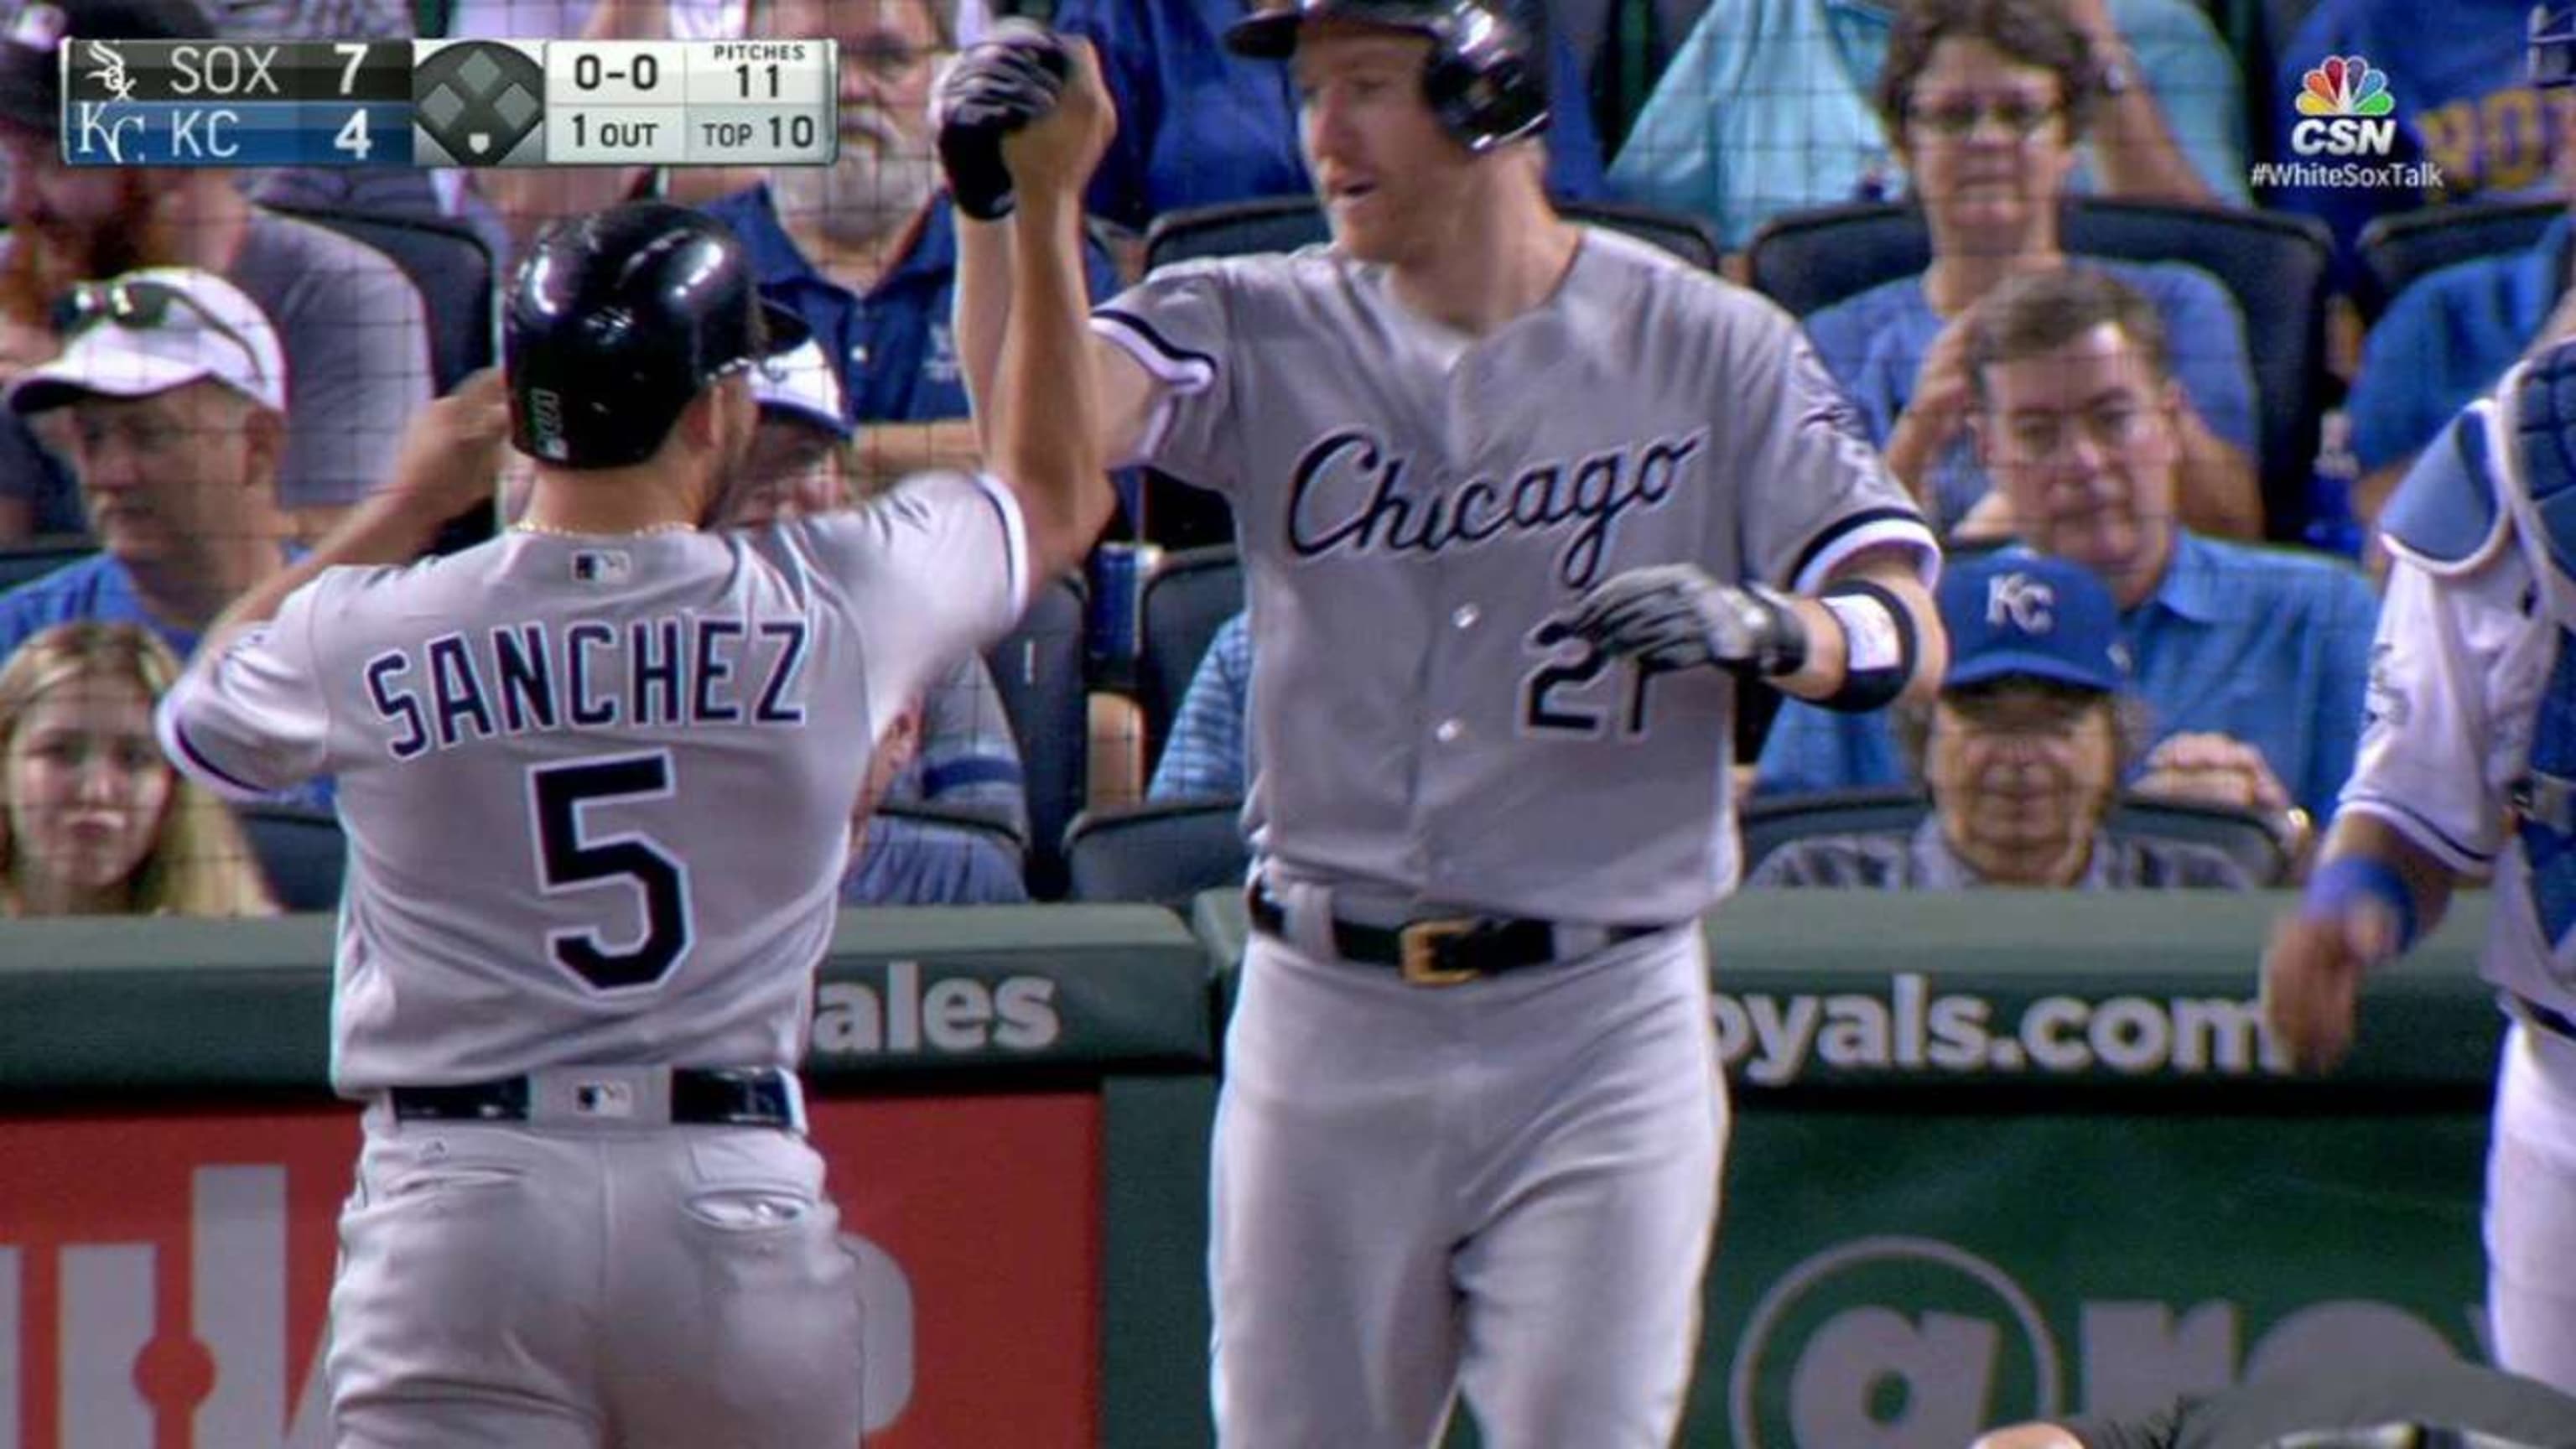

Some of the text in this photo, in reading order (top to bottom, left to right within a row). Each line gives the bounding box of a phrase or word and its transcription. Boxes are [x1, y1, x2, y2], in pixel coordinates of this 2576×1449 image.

[1287, 429, 1701, 589] Chicago
[1985, 572, 2054, 634] KC
[366, 610, 811, 761] SANCHEZ
[527, 750, 693, 995] 5
[813, 961, 1061, 1053] ales
